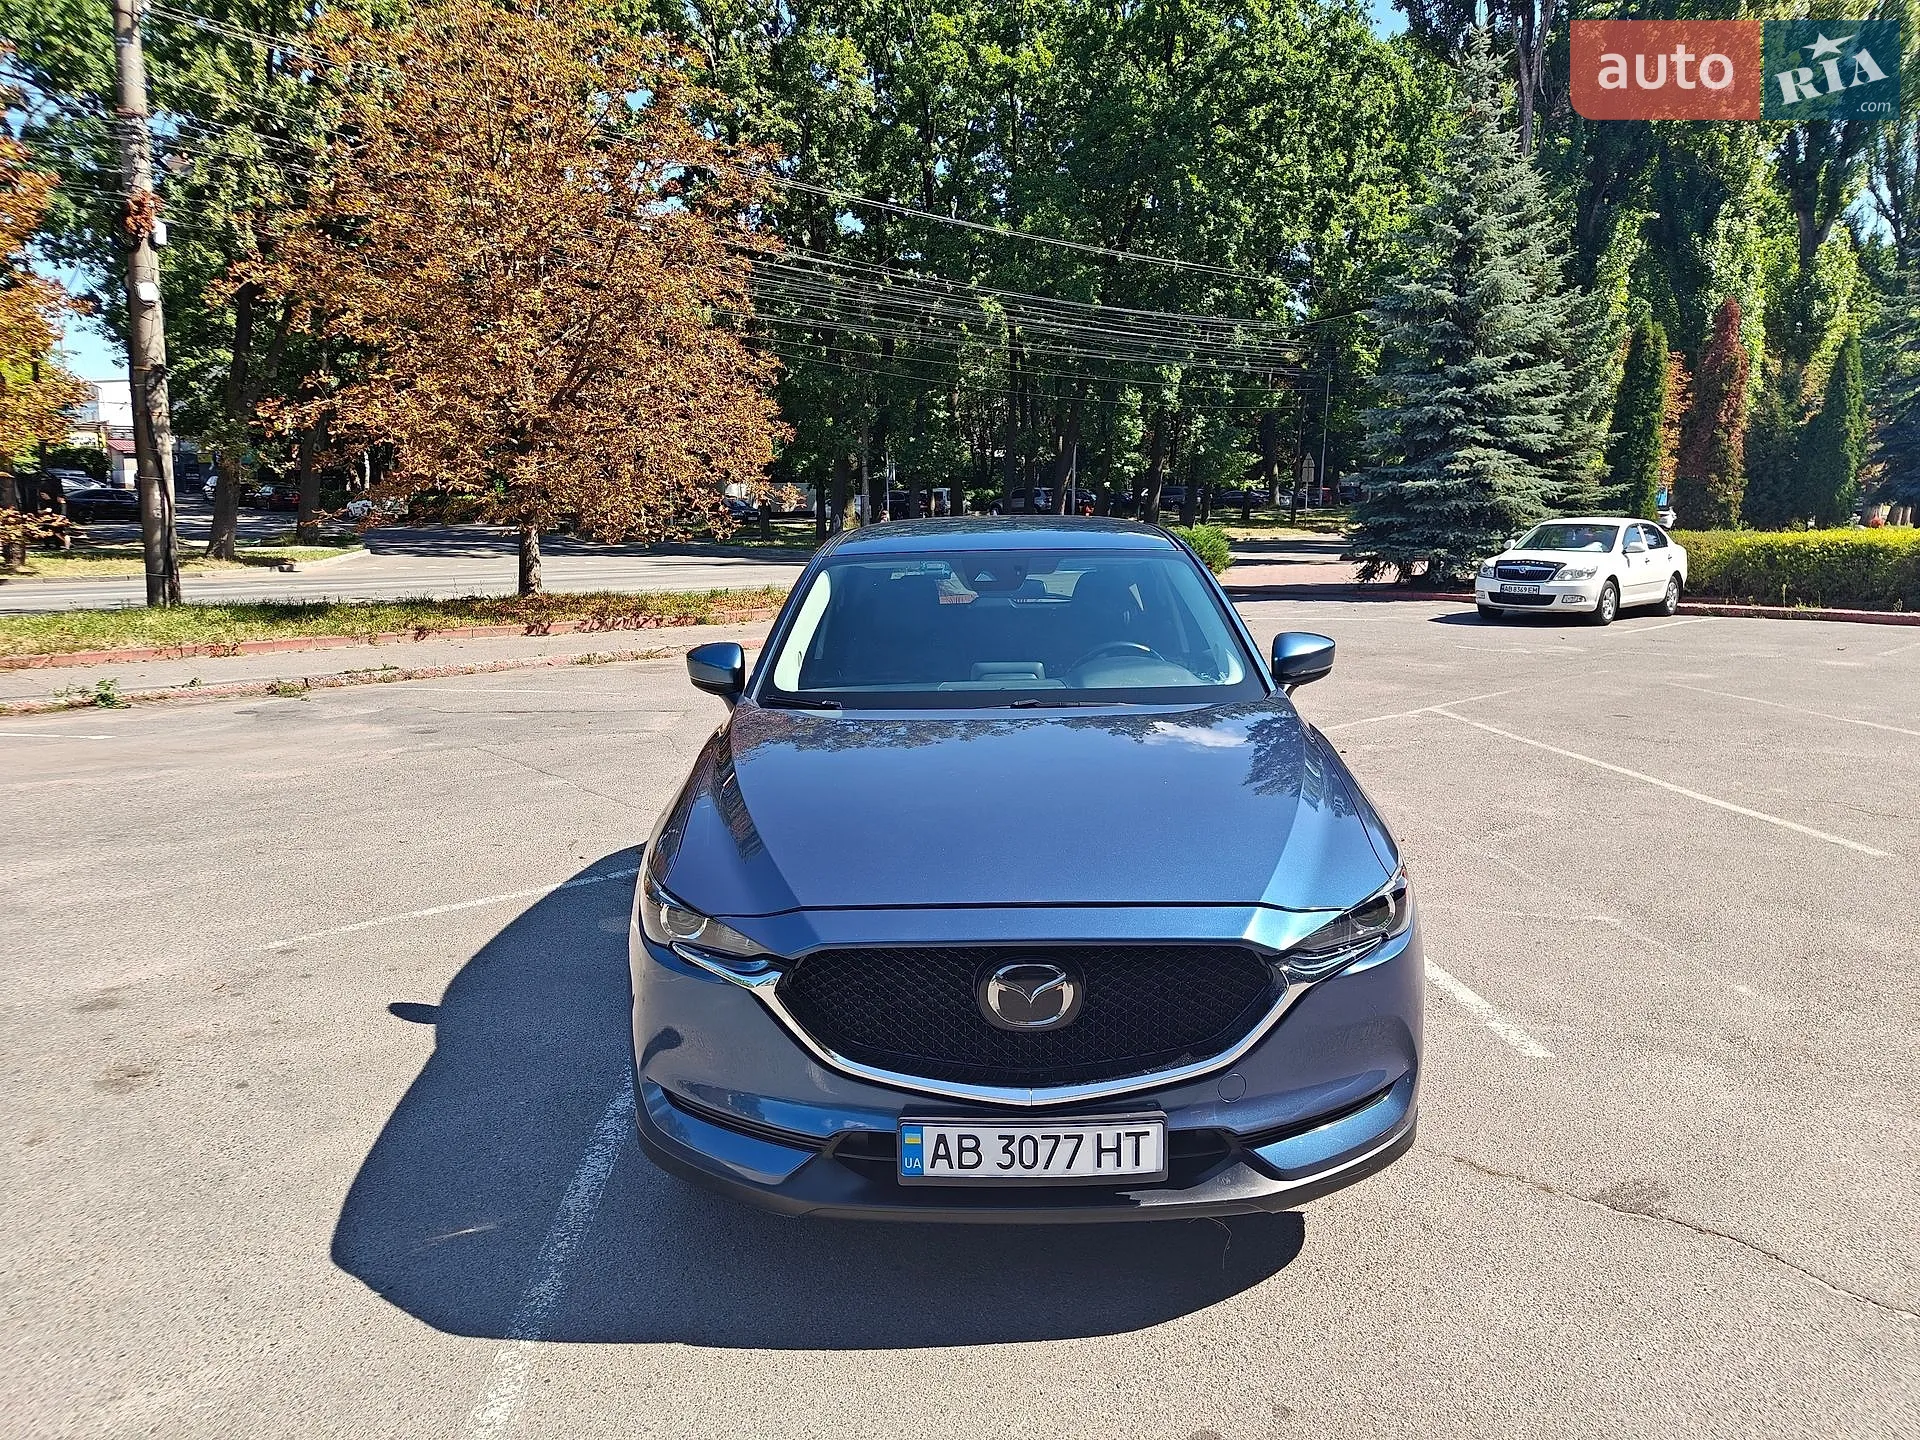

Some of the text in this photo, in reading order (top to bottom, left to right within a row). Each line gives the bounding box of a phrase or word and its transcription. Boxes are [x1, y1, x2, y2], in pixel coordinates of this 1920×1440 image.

[904, 1157, 921, 1169] UA
[929, 1131, 1150, 1170] AB 3077 HT
